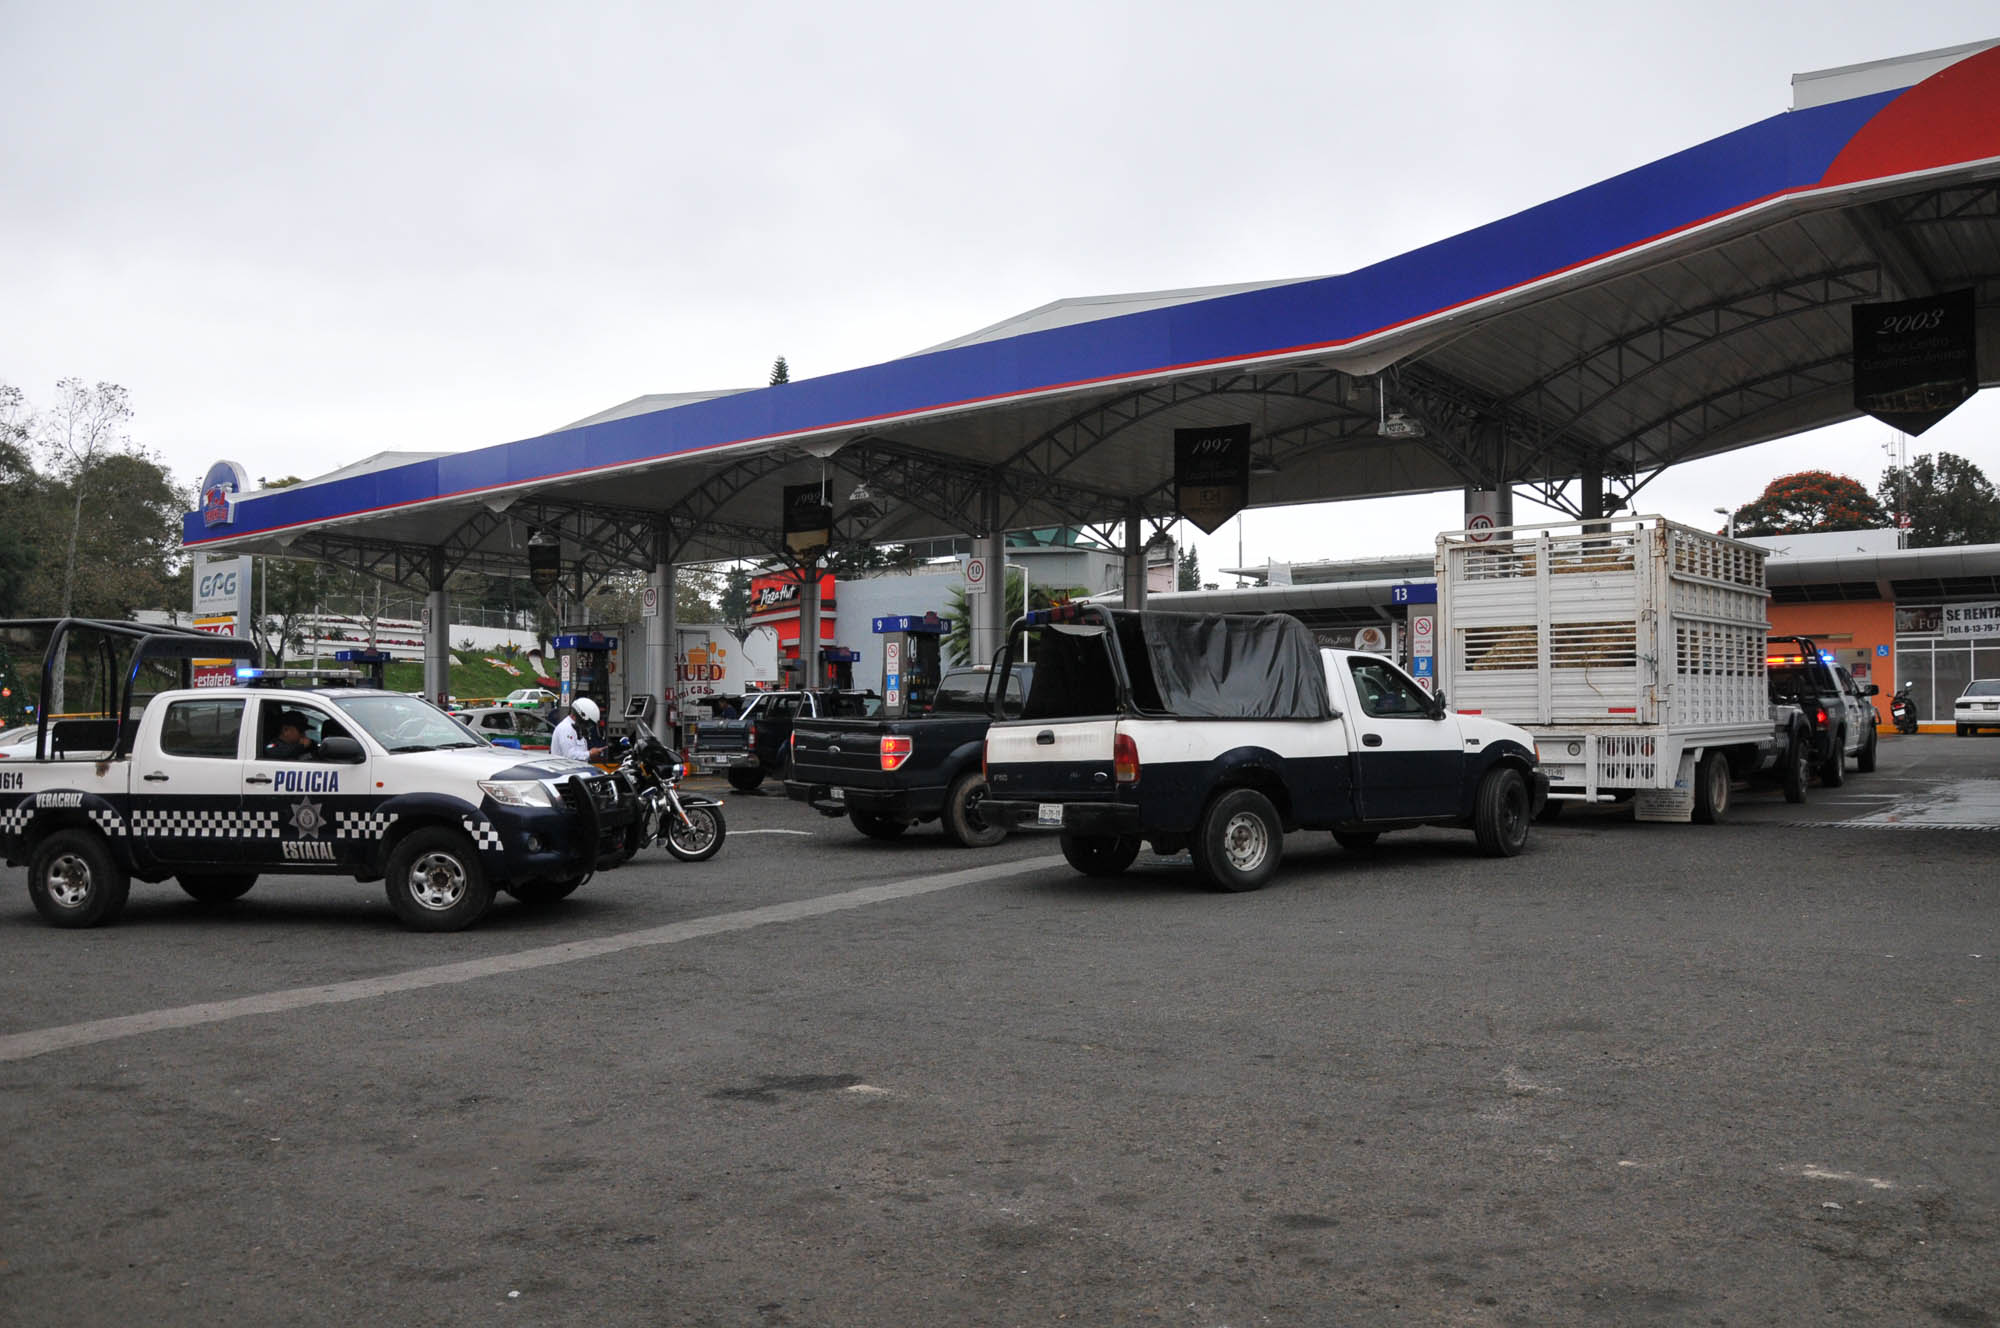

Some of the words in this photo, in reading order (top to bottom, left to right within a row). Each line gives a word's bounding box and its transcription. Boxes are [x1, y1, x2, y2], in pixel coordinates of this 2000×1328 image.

[1875, 308, 1945, 335] 2003
[1192, 438, 1234, 456] 1997
[971, 564, 981, 575] 10
[761, 588, 780, 606] Pizza
[780, 585, 796, 601] Hut
[1394, 588, 1408, 601] 13
[1946, 608, 1961, 622] SE
[1964, 605, 2000, 621] RENTA
[877, 619, 883, 631] 9
[899, 618, 908, 629] 10
[197, 672, 232, 688] estafeta
[273, 770, 339, 793] POLICIA
[35, 792, 84, 808] VERACRUZ
[281, 840, 337, 861] ESTATAL
